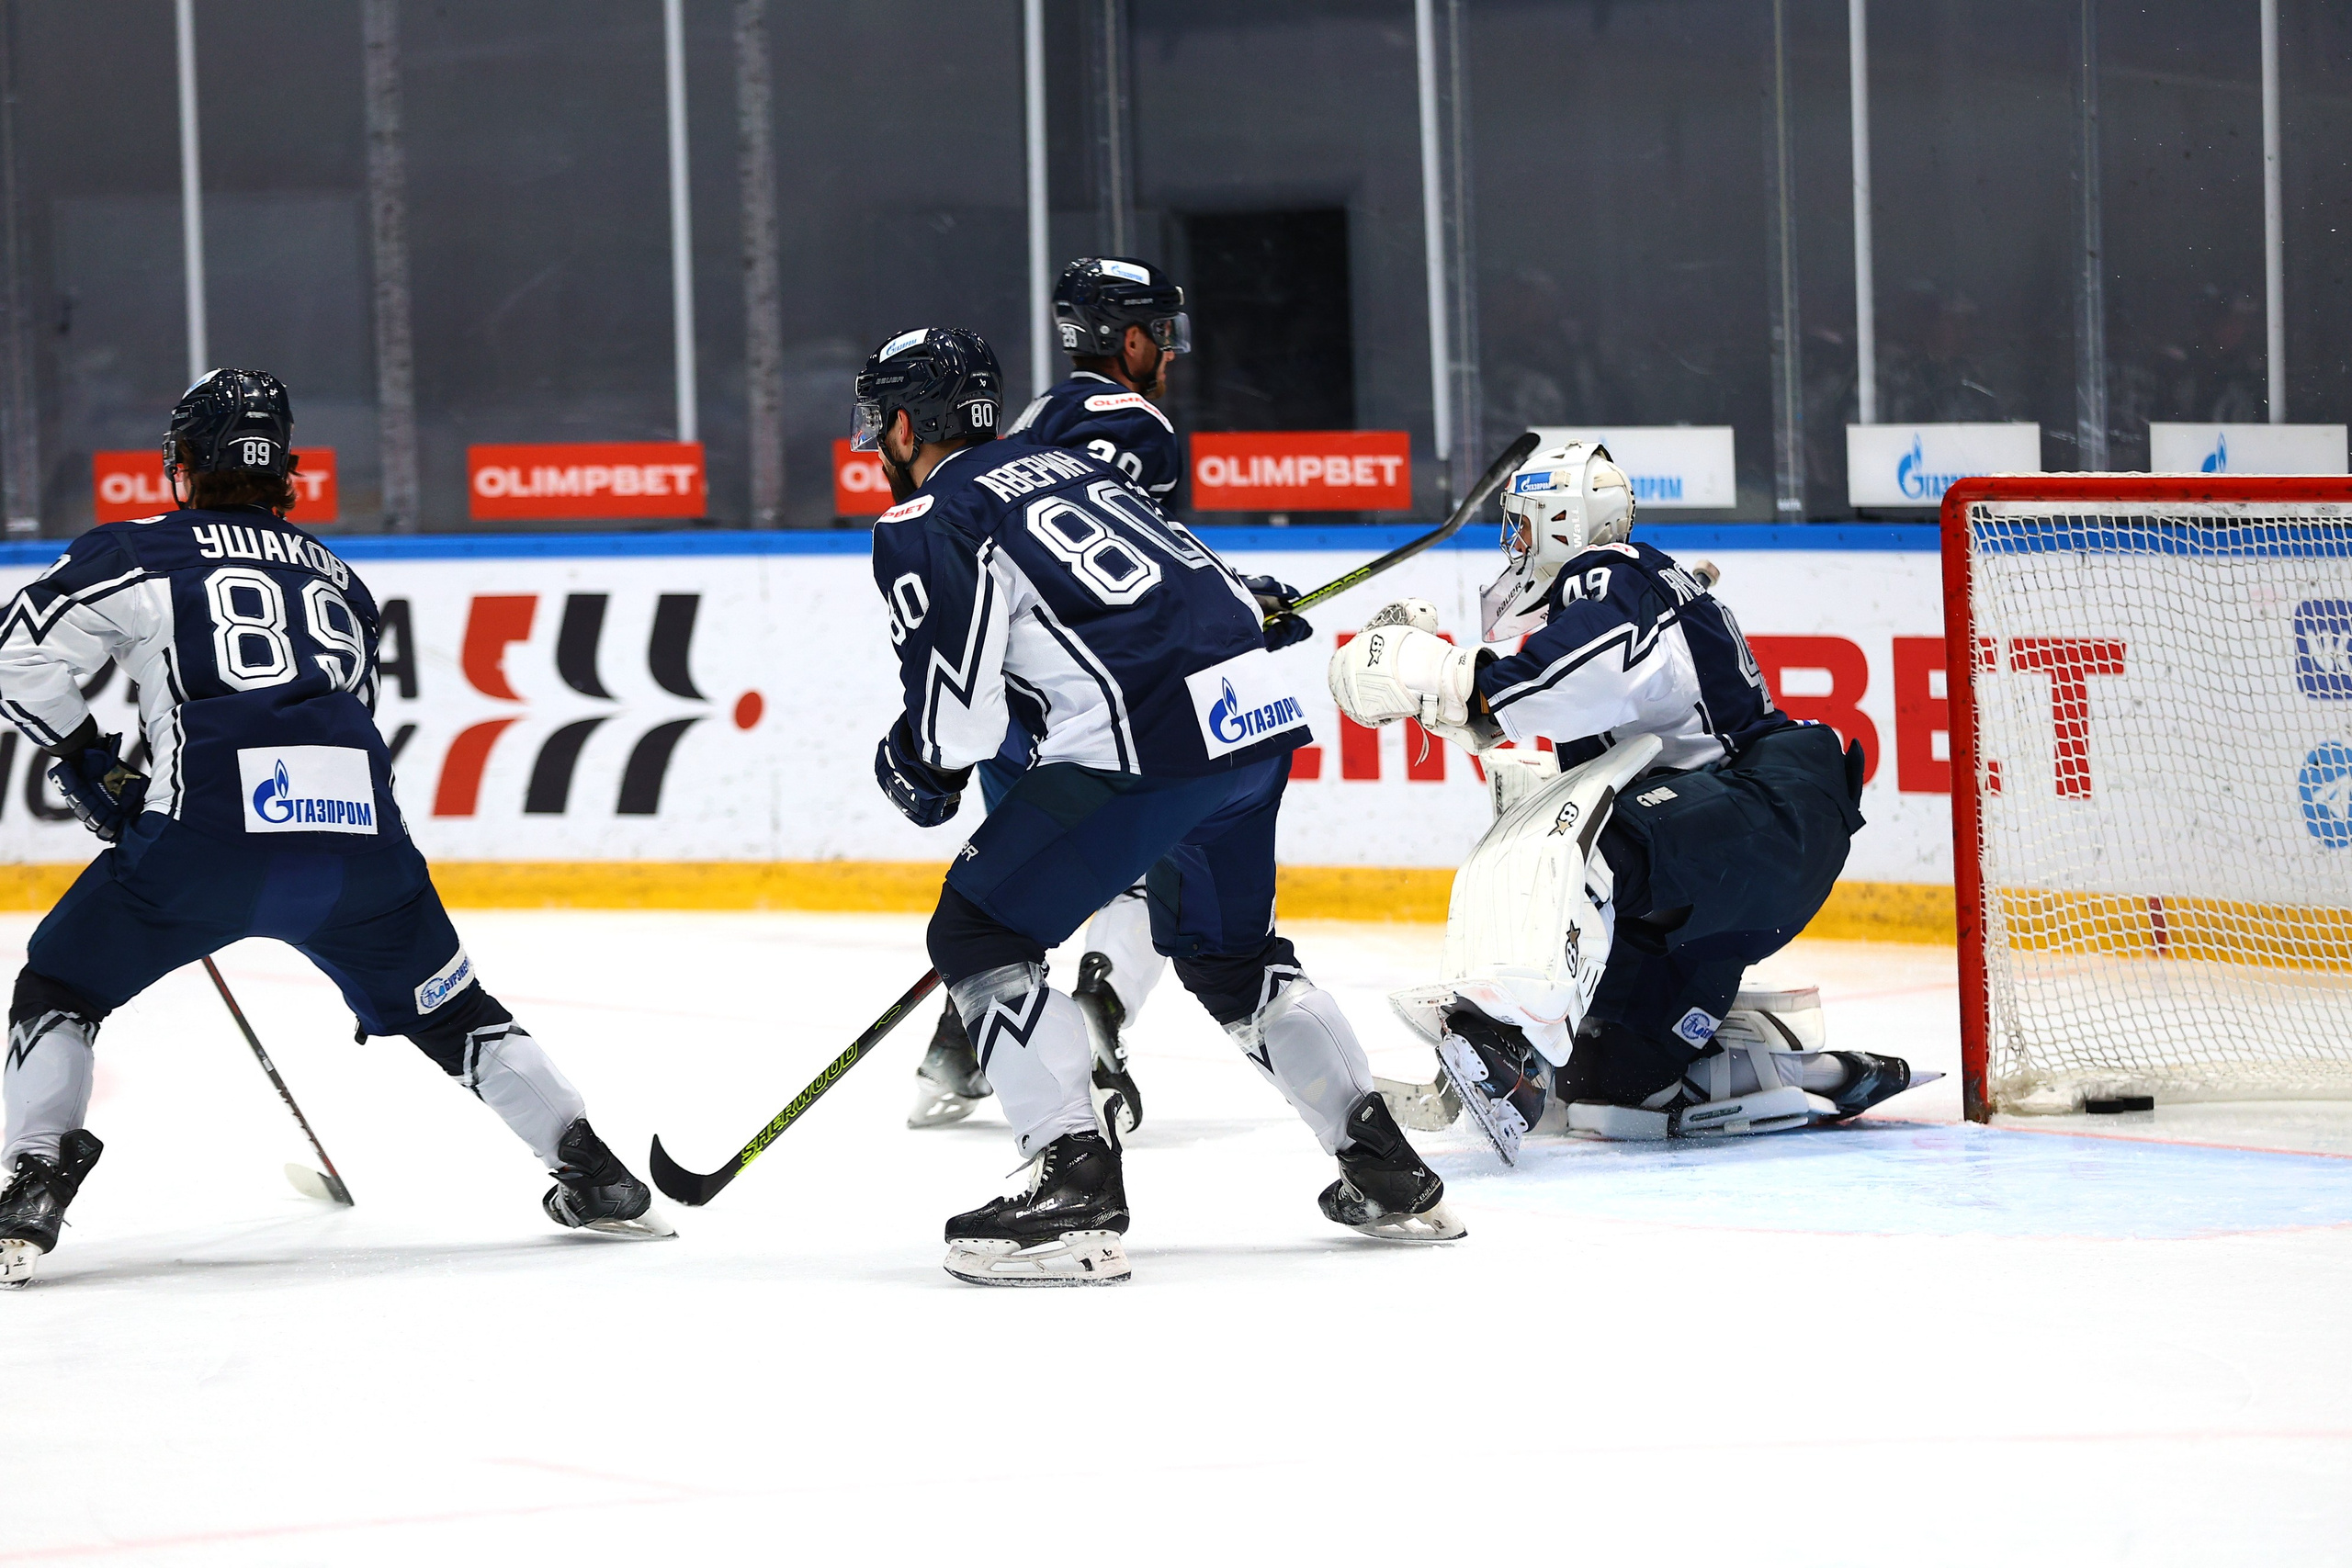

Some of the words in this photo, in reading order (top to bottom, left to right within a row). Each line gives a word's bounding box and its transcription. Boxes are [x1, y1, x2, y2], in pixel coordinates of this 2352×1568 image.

[971, 403, 993, 428] 80
[243, 441, 270, 466] 89
[1196, 454, 1405, 488] OLIMPBET
[474, 463, 698, 499] OLIMPBET
[973, 450, 1096, 504] АВЕРИН
[881, 502, 927, 519] PBET
[192, 524, 349, 591] УШАКОВ
[1023, 478, 1215, 607] 80
[202, 566, 368, 694] 89
[295, 798, 372, 827] ГАЗПРОМ
[741, 1040, 858, 1164] SHERWOOD
